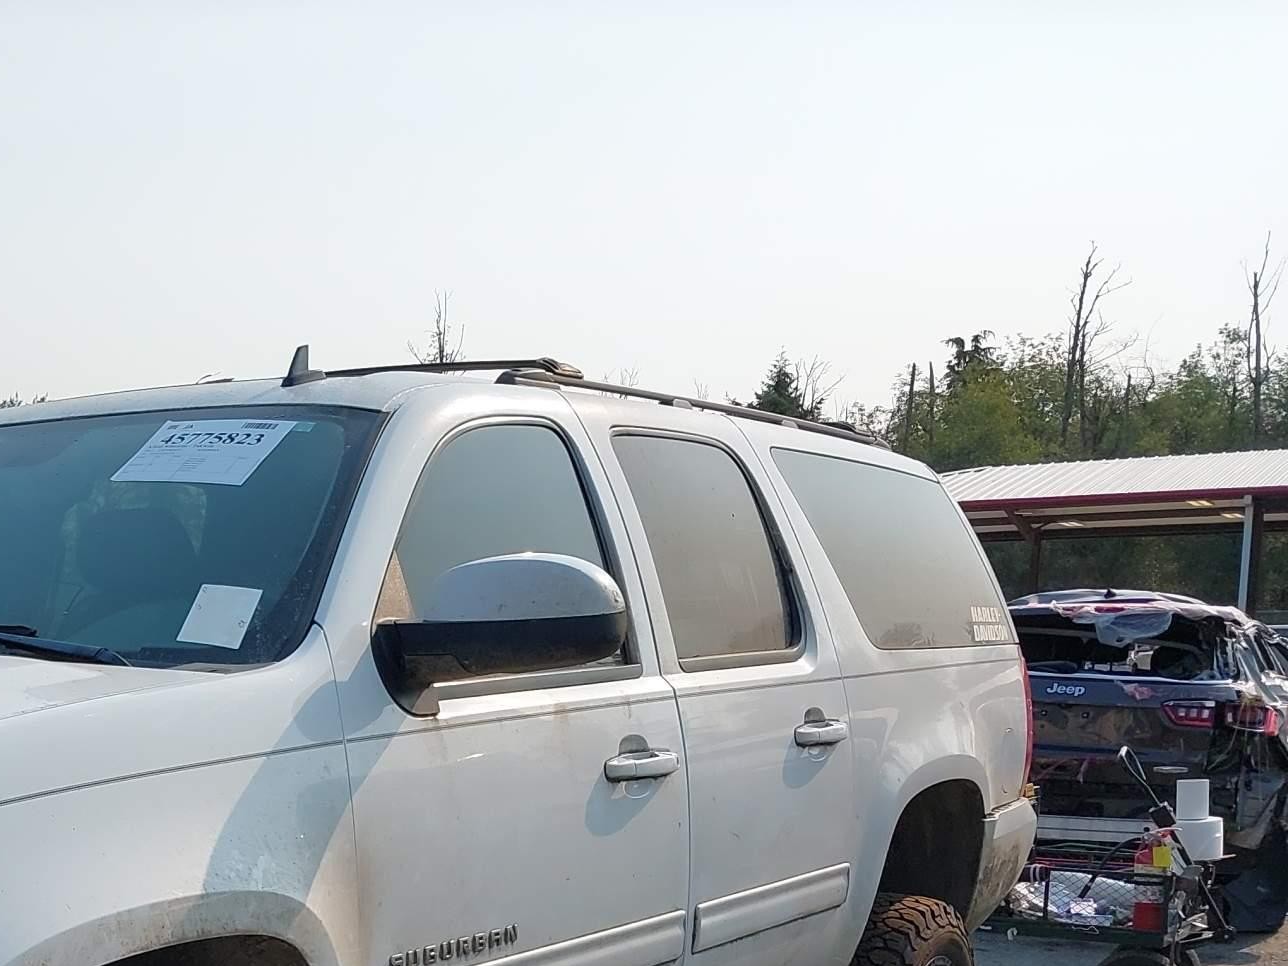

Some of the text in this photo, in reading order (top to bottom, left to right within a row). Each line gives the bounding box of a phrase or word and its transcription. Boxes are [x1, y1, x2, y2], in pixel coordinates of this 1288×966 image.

[161, 433, 265, 445] 45775823
[973, 625, 1008, 641] DAVIDSON
[1046, 682, 1086, 697] Jeep
